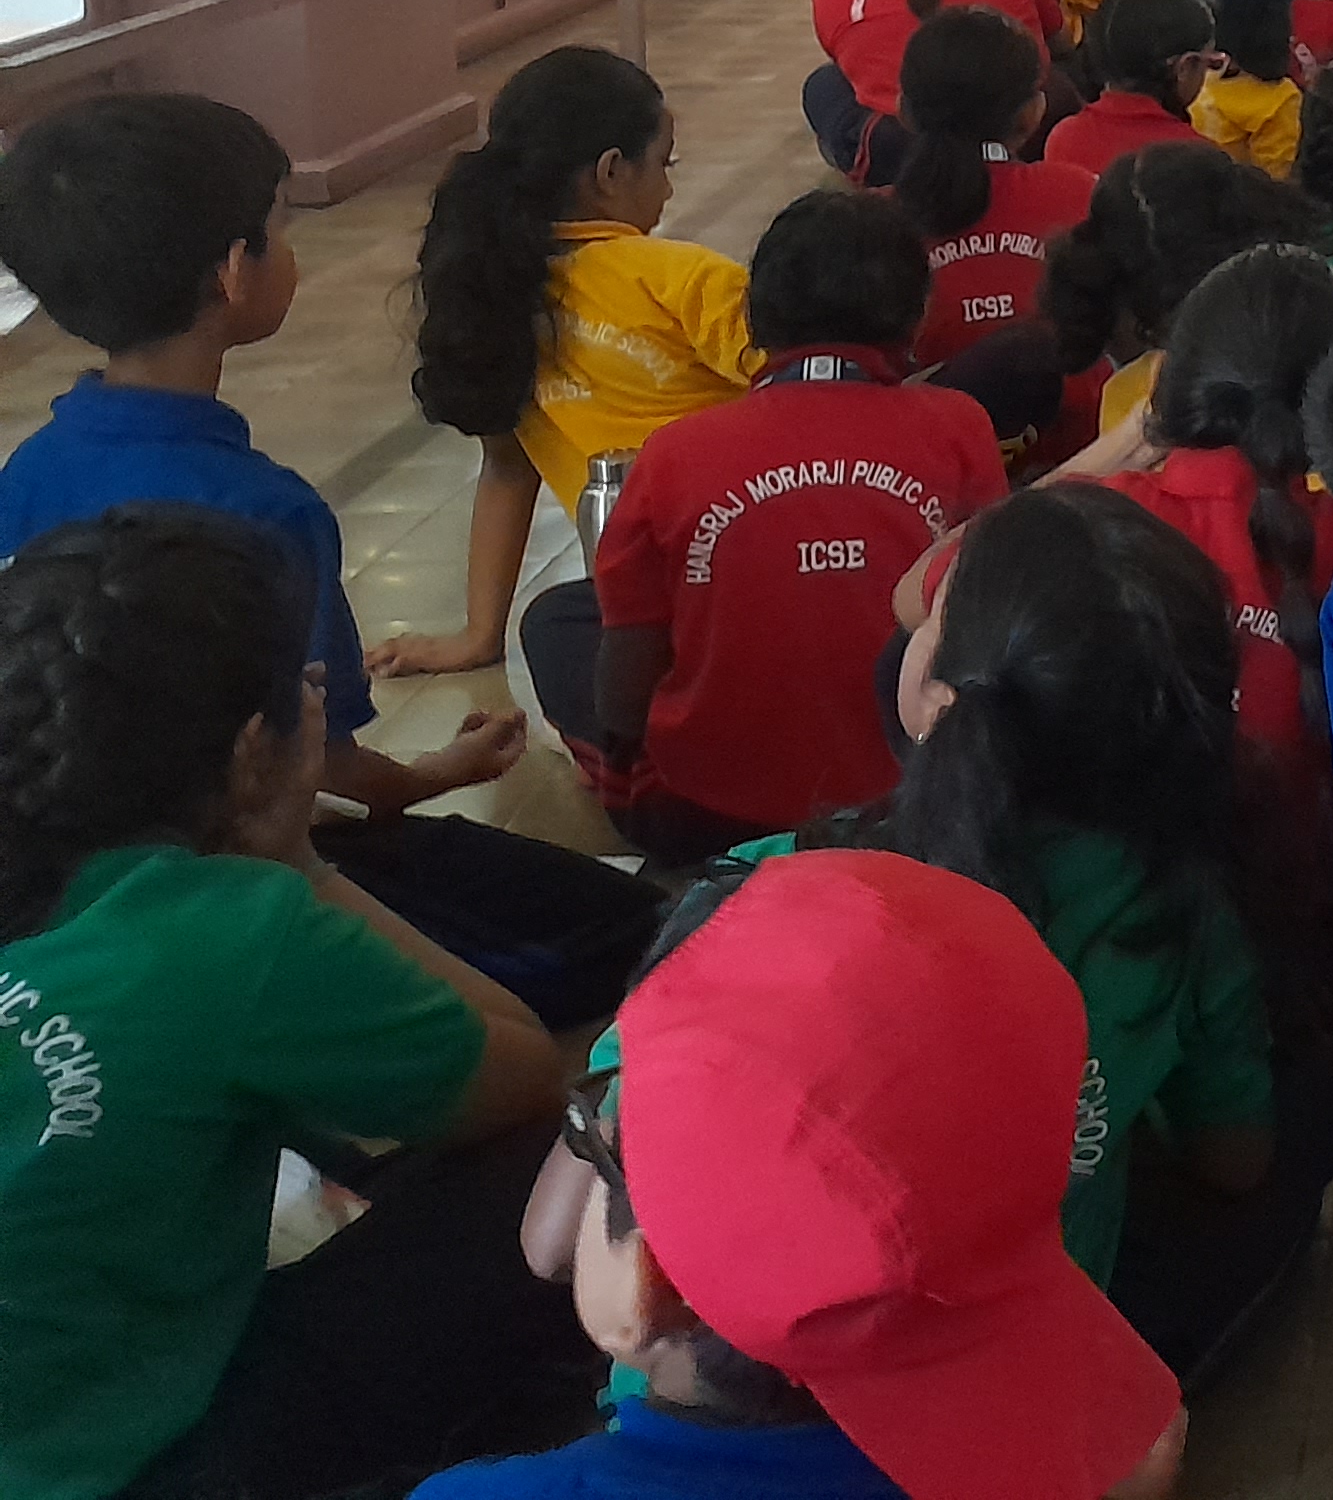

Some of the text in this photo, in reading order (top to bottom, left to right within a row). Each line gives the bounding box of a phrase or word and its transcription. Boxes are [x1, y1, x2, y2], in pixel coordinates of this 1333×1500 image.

[961, 294, 1015, 323] ICSE
[686, 489, 746, 585] HANSRAJ
[743, 458, 847, 505] MORARJI
[850, 459, 924, 505] PUBLIC
[796, 539, 866, 574] ICSE
[20, 1013, 104, 1147] SCHOOL
